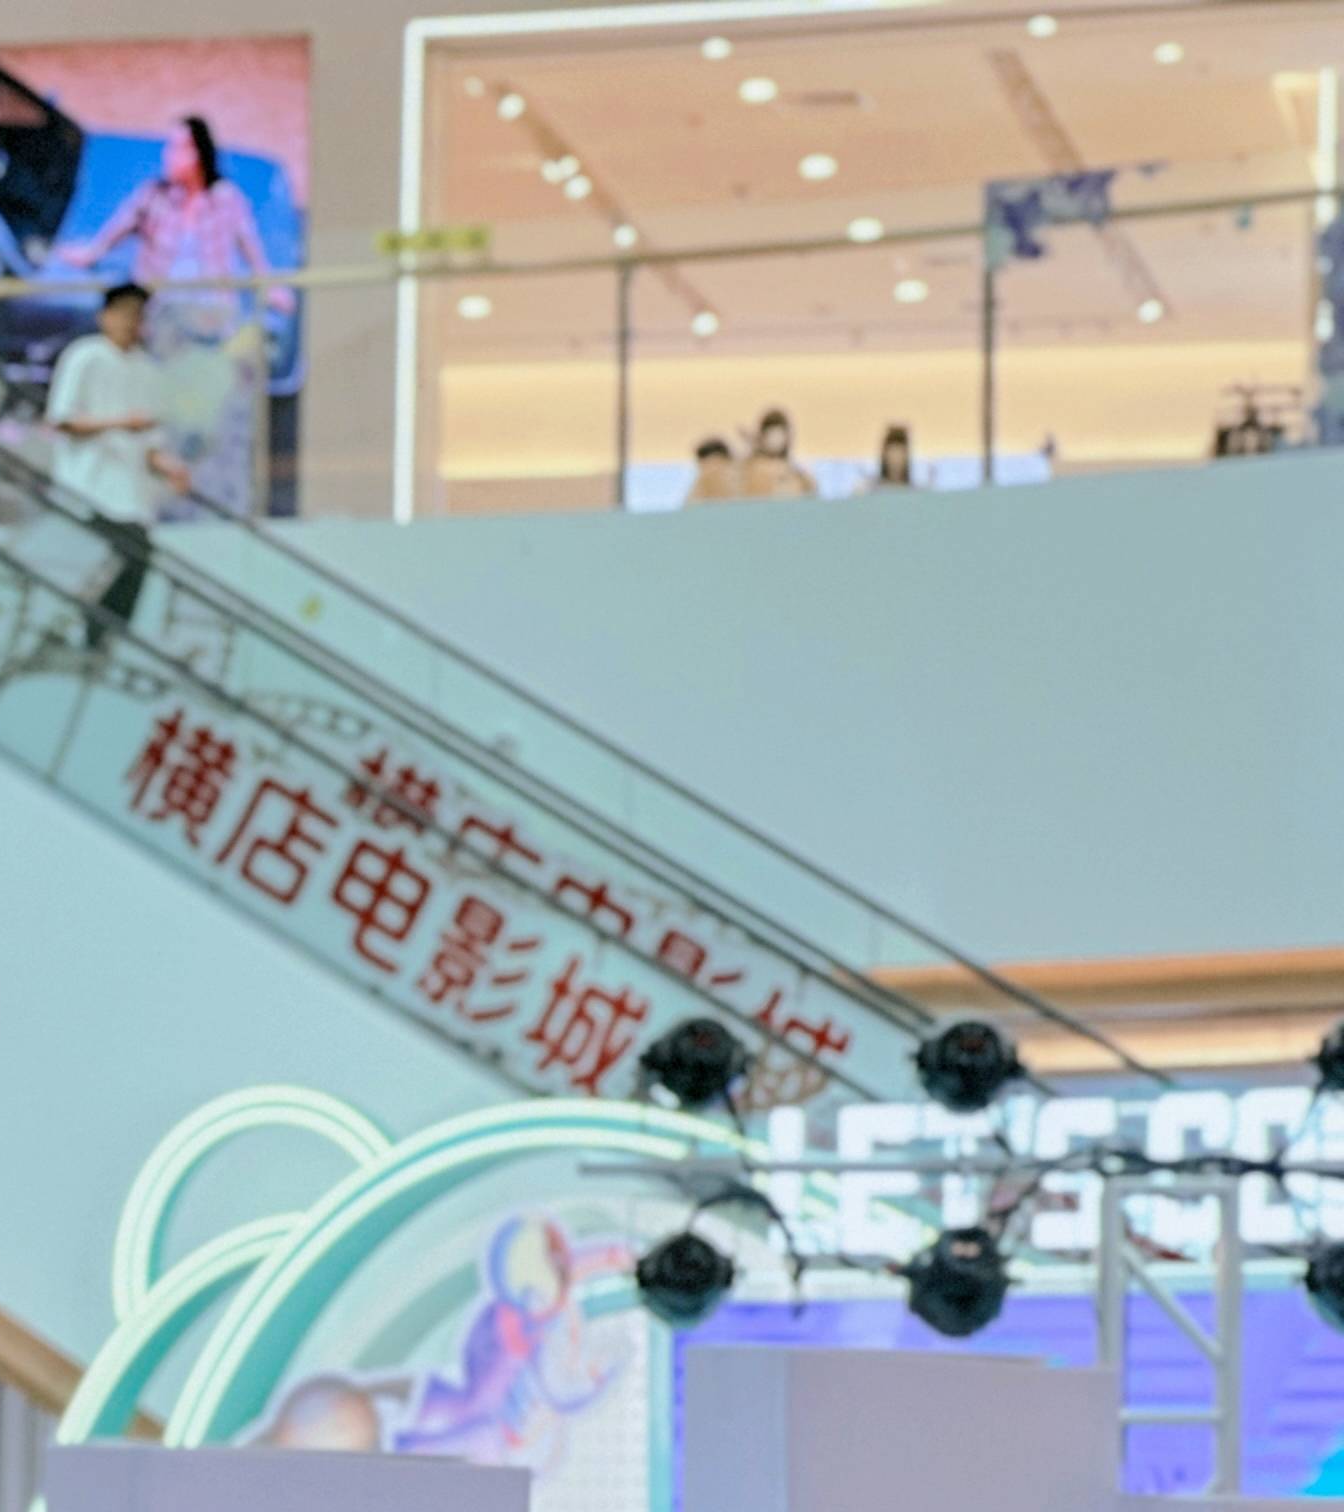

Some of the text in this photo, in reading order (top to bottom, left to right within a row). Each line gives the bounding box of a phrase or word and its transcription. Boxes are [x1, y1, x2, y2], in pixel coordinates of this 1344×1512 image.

[125, 708, 649, 1096] 横店电影城
